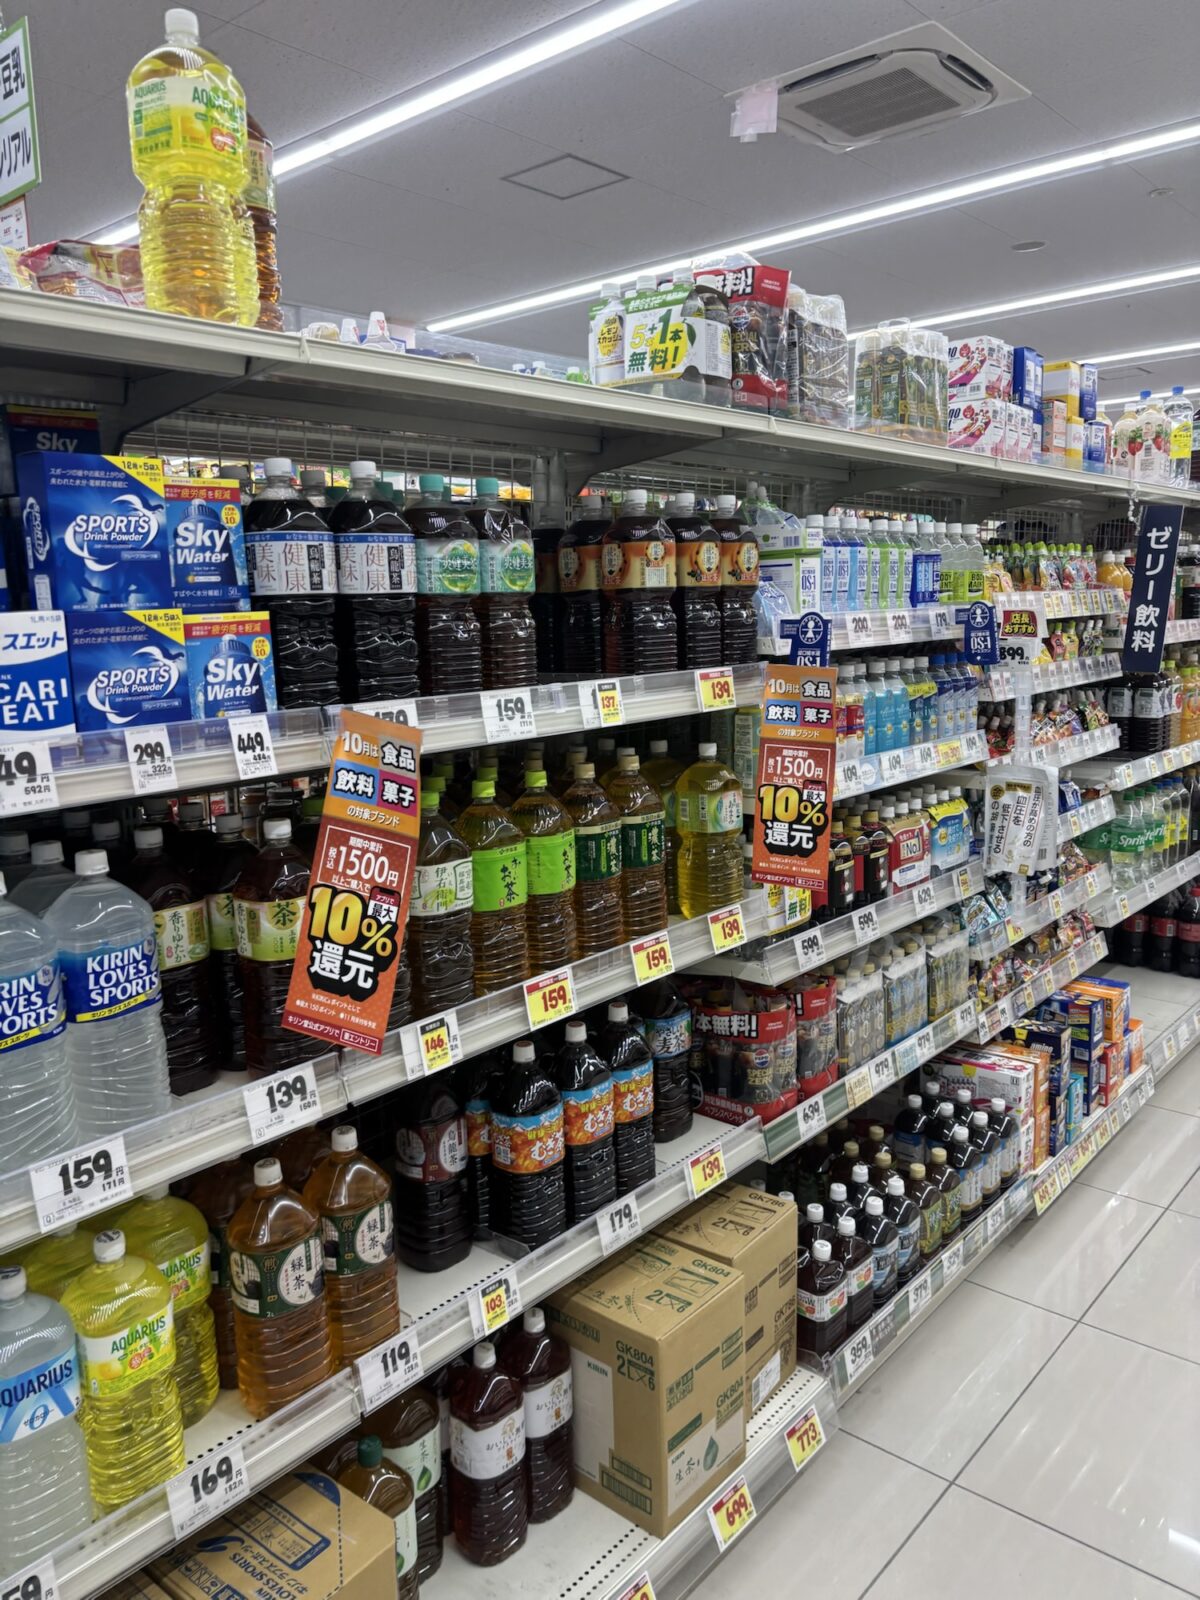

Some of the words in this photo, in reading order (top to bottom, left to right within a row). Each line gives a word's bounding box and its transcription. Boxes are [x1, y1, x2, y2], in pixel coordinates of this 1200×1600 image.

[627, 347, 680, 373] 無料!
[36, 432, 78, 453] Sky
[75, 515, 150, 534] SPORTS
[83, 532, 108, 542] Drink
[111, 531, 144, 543] Powder
[176, 522, 228, 551] Sky
[176, 547, 229, 565] Water
[256, 542, 277, 583] 美味
[282, 542, 307, 592] 健康
[340, 545, 359, 583] 美味
[364, 544, 387, 592] 健康
[801, 574, 817, 591] OS-1
[1130, 525, 1173, 654] ゼリー飲料
[852, 616, 869, 633] 200
[892, 613, 908, 631] 200
[1003, 624, 1036, 635] おすすめ
[1011, 611, 1030, 624] 店長
[2, 631, 65, 650] スエット
[970, 636, 992, 650] OS-1
[97, 666, 171, 688] SPORTS
[206, 657, 259, 687] Sky
[105, 686, 129, 696] Drink
[132, 683, 164, 693] Powder
[207, 684, 260, 702] Water
[711, 681, 731, 700] 139
[768, 678, 800, 694] 10月は
[802, 680, 832, 699] 食品
[495, 697, 526, 722] 159
[600, 696, 615, 709] 137
[766, 704, 798, 722] 飲料
[803, 706, 832, 724] 菓子
[133, 741, 166, 766] 299
[237, 732, 265, 753] 449
[341, 731, 379, 758] 10月は
[382, 743, 416, 772] 食品
[775, 756, 824, 779] 1500円
[843, 765, 858, 783] 109
[887, 754, 902, 772] 109
[335, 769, 375, 798] 飲料
[382, 780, 416, 807] 菓子
[346, 804, 401, 829] の対象ブランド
[759, 785, 826, 827] 10%
[765, 821, 815, 850] 還元
[326, 846, 337, 870] 税込
[338, 846, 400, 887] 1500円
[331, 874, 371, 892] 以上ご購入で
[433, 866, 449, 912] 伊右衛門
[917, 887, 932, 903] 629
[271, 901, 298, 927] 茶
[310, 886, 393, 958] 10%
[371, 903, 396, 922] 最大
[858, 910, 875, 929] 599
[168, 910, 187, 963] 香りゆたか
[720, 918, 741, 940] 139
[801, 934, 820, 956] 599
[87, 944, 143, 975] KIRIN
[309, 939, 376, 990] 還元
[645, 946, 668, 971] 159
[88, 960, 148, 990] LOVES
[89, 972, 159, 1008] SPORTS
[541, 985, 567, 1013] 159
[960, 1005, 972, 1022] 979
[424, 1034, 445, 1053] 146
[916, 1031, 931, 1048] 979
[874, 1057, 890, 1078] 979
[266, 1074, 308, 1114] 139
[622, 1084, 654, 1113] むぎ茶
[583, 1101, 614, 1132] むぎ茶
[802, 1102, 820, 1124] 639
[531, 1130, 564, 1161] むぎ茶
[57, 1149, 114, 1197] 159
[702, 1158, 720, 1179] 139
[101, 1178, 125, 1193] 171円
[748, 1191, 787, 1209] GK786
[609, 1203, 634, 1233] 179
[366, 1218, 380, 1251] 緑茶
[290, 1256, 306, 1291] 緑茶
[691, 1258, 733, 1279] GK804
[485, 1294, 503, 1315] 103
[111, 1315, 167, 1355] AQUARIUS
[380, 1341, 412, 1379] 119
[615, 1339, 655, 1369] GK804
[850, 1336, 868, 1365] 359
[587, 1359, 609, 1379] KIRIN
[0, 1359, 73, 1408] QUARIUS
[796, 1420, 818, 1454] 773
[189, 1455, 234, 1503] 169
[726, 1492, 750, 1528] 699
